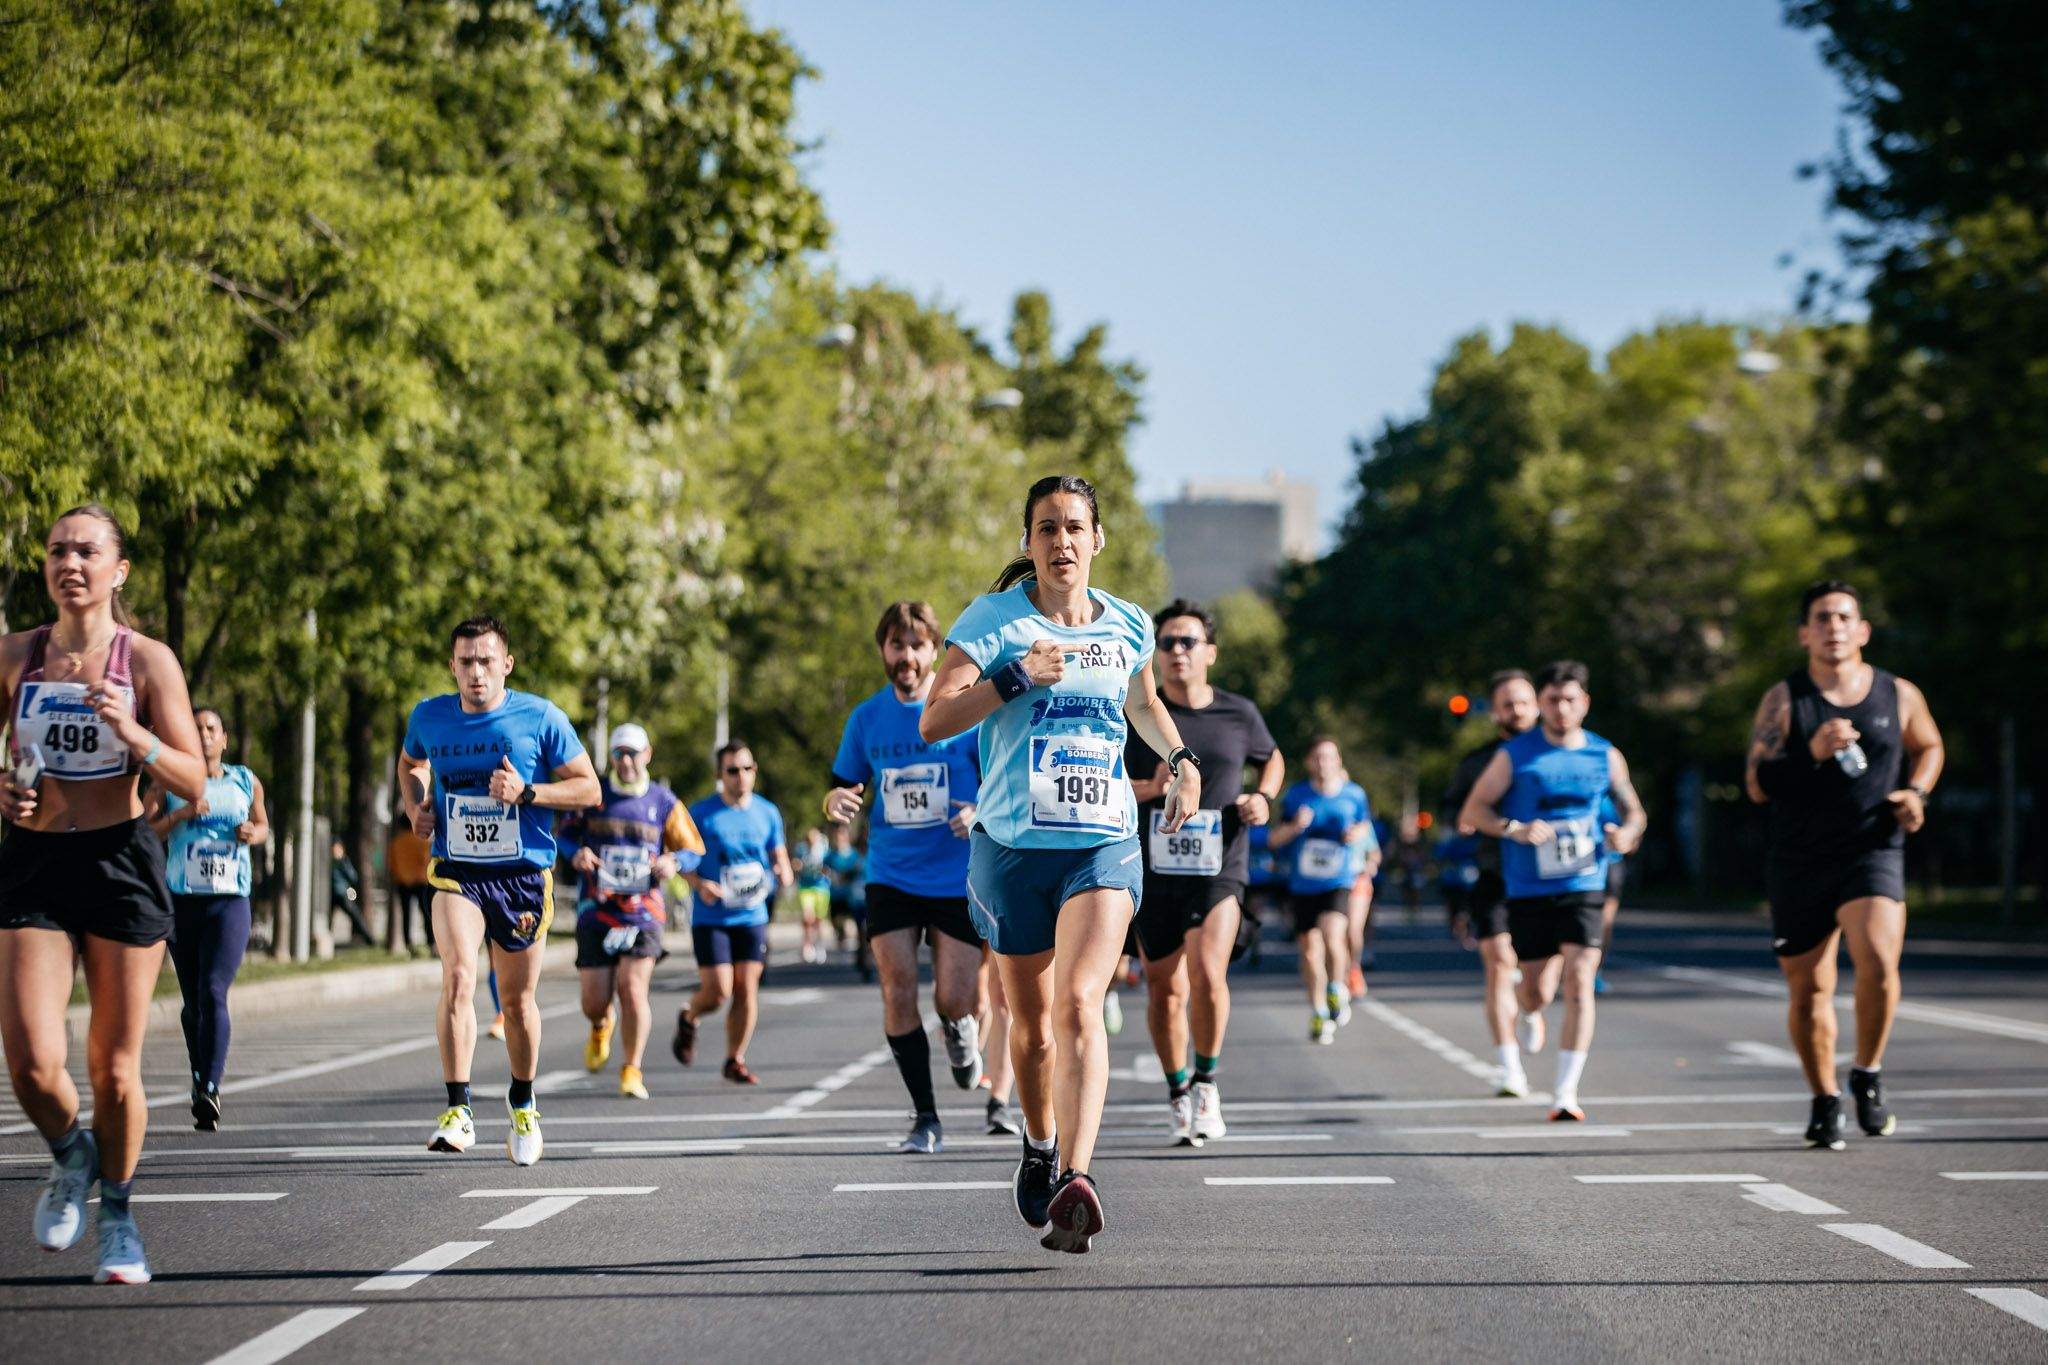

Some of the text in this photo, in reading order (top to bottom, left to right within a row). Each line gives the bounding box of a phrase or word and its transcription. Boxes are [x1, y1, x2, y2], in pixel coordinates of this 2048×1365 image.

[1083, 707, 1096, 717] de
[45, 724, 98, 753] 498
[430, 741, 513, 758] DECIMAS
[1061, 765, 1109, 777] DECIMAS
[1054, 775, 1109, 806] 1937
[902, 791, 928, 811] 154
[464, 823, 500, 843] 332
[1168, 838, 1202, 856] 599
